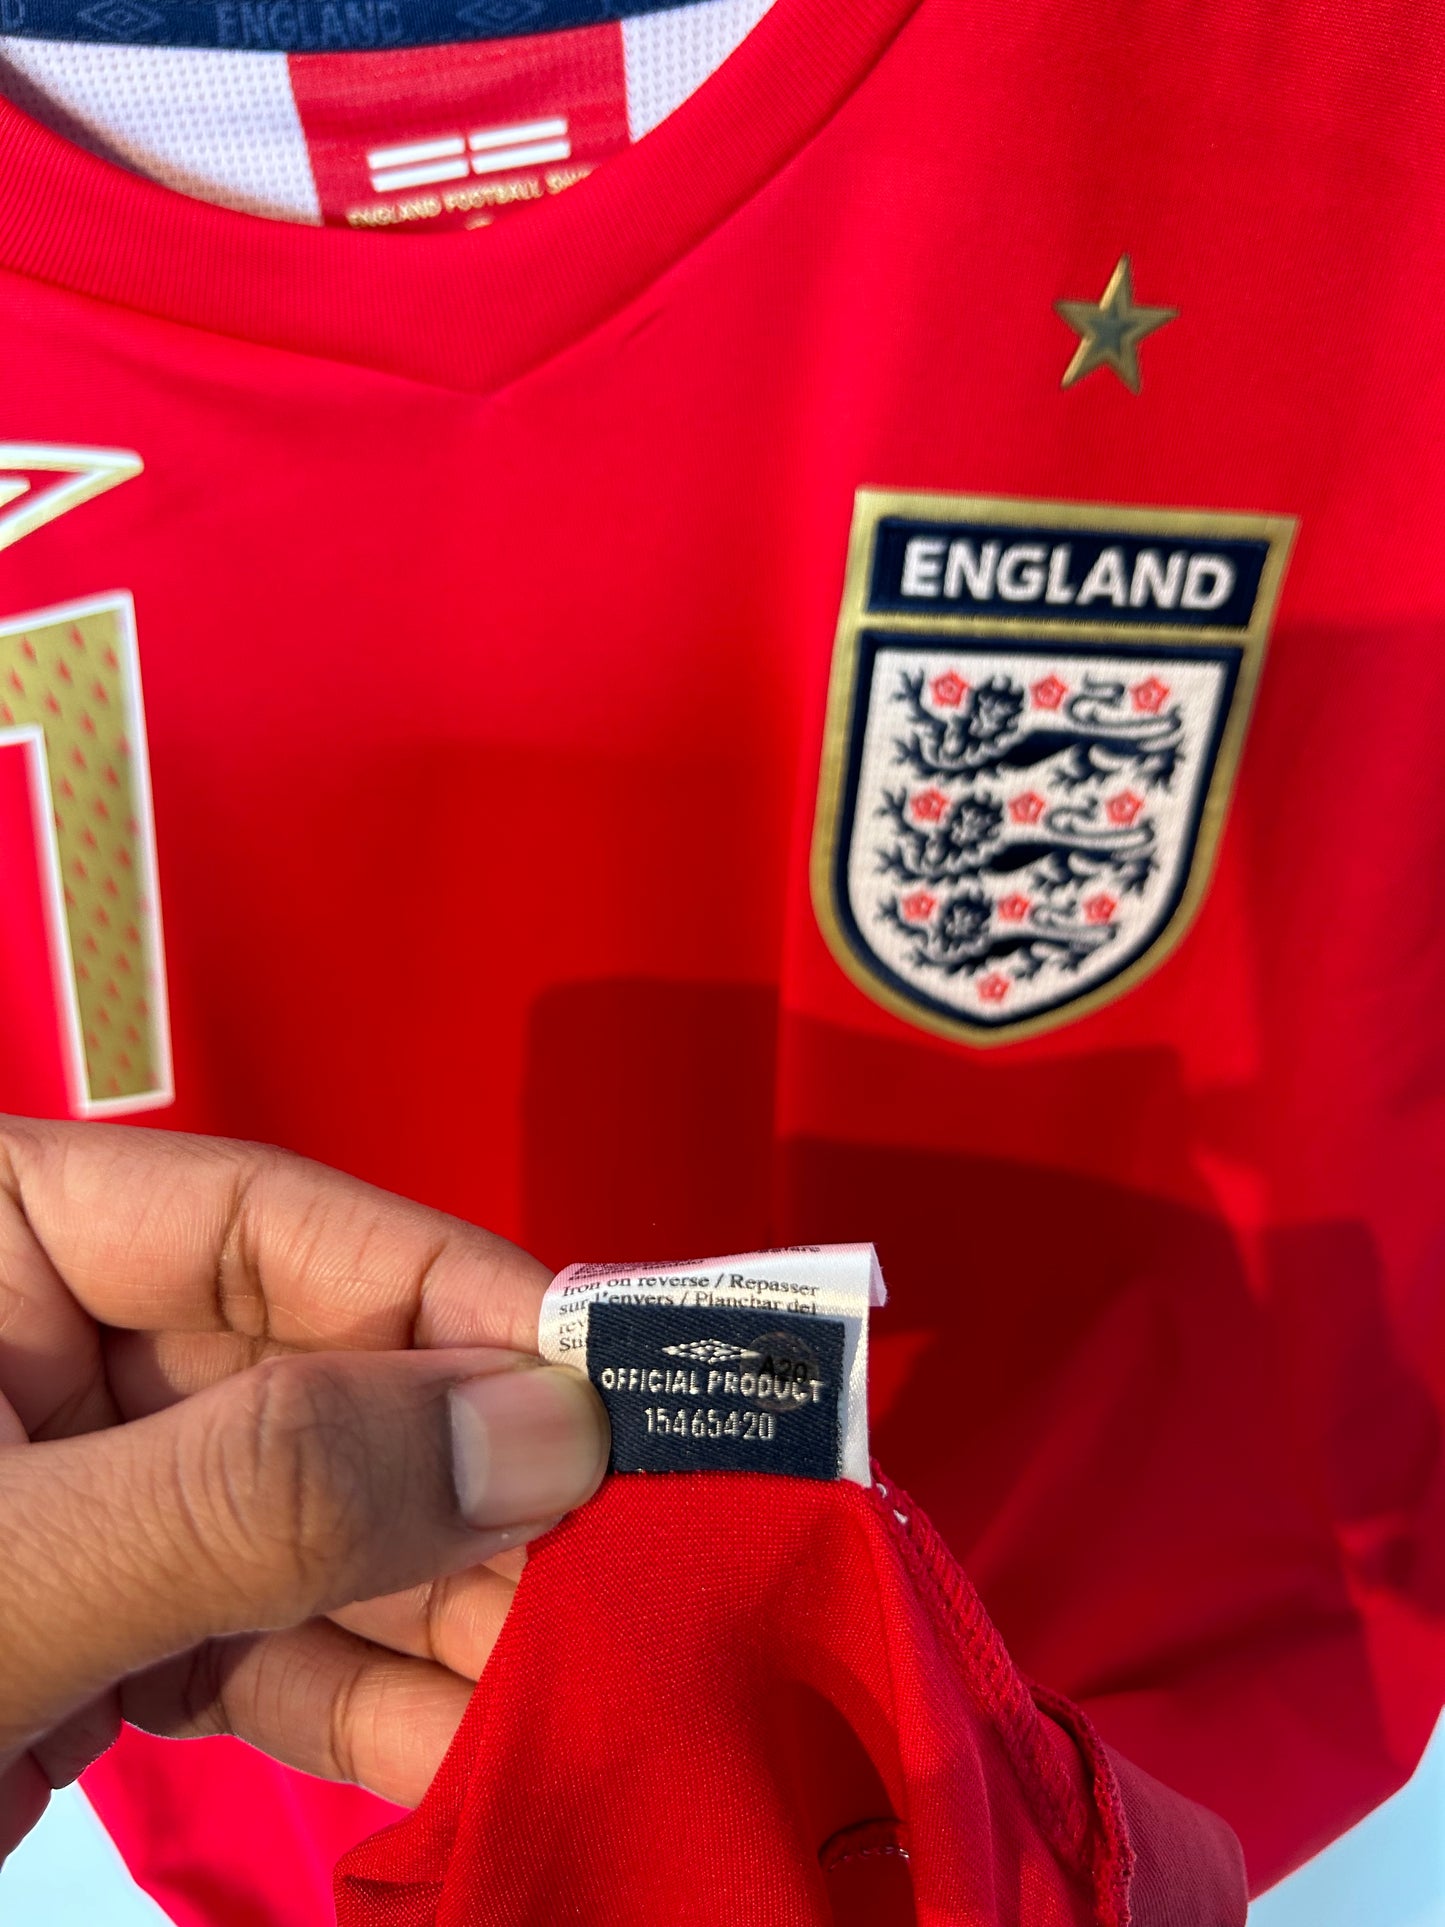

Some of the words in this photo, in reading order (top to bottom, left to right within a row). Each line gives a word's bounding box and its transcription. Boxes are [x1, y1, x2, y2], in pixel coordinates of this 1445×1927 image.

[216, 1, 400, 47] ENGLAND
[900, 537, 1236, 610] ENGLAND
[563, 1281, 601, 1297] Iron
[606, 1276, 631, 1288] on
[637, 1276, 710, 1289] reverse
[714, 1273, 726, 1289] /
[729, 1273, 820, 1297] Repasser
[559, 1299, 588, 1315] sur
[595, 1291, 674, 1305] l'envers
[695, 1290, 779, 1310] Planchar
[786, 1302, 817, 1315] del
[600, 1367, 701, 1396] OFFICIAL
[707, 1370, 825, 1404] PRODUCT
[758, 1354, 808, 1384] A20
[644, 1407, 777, 1441] 15465420
